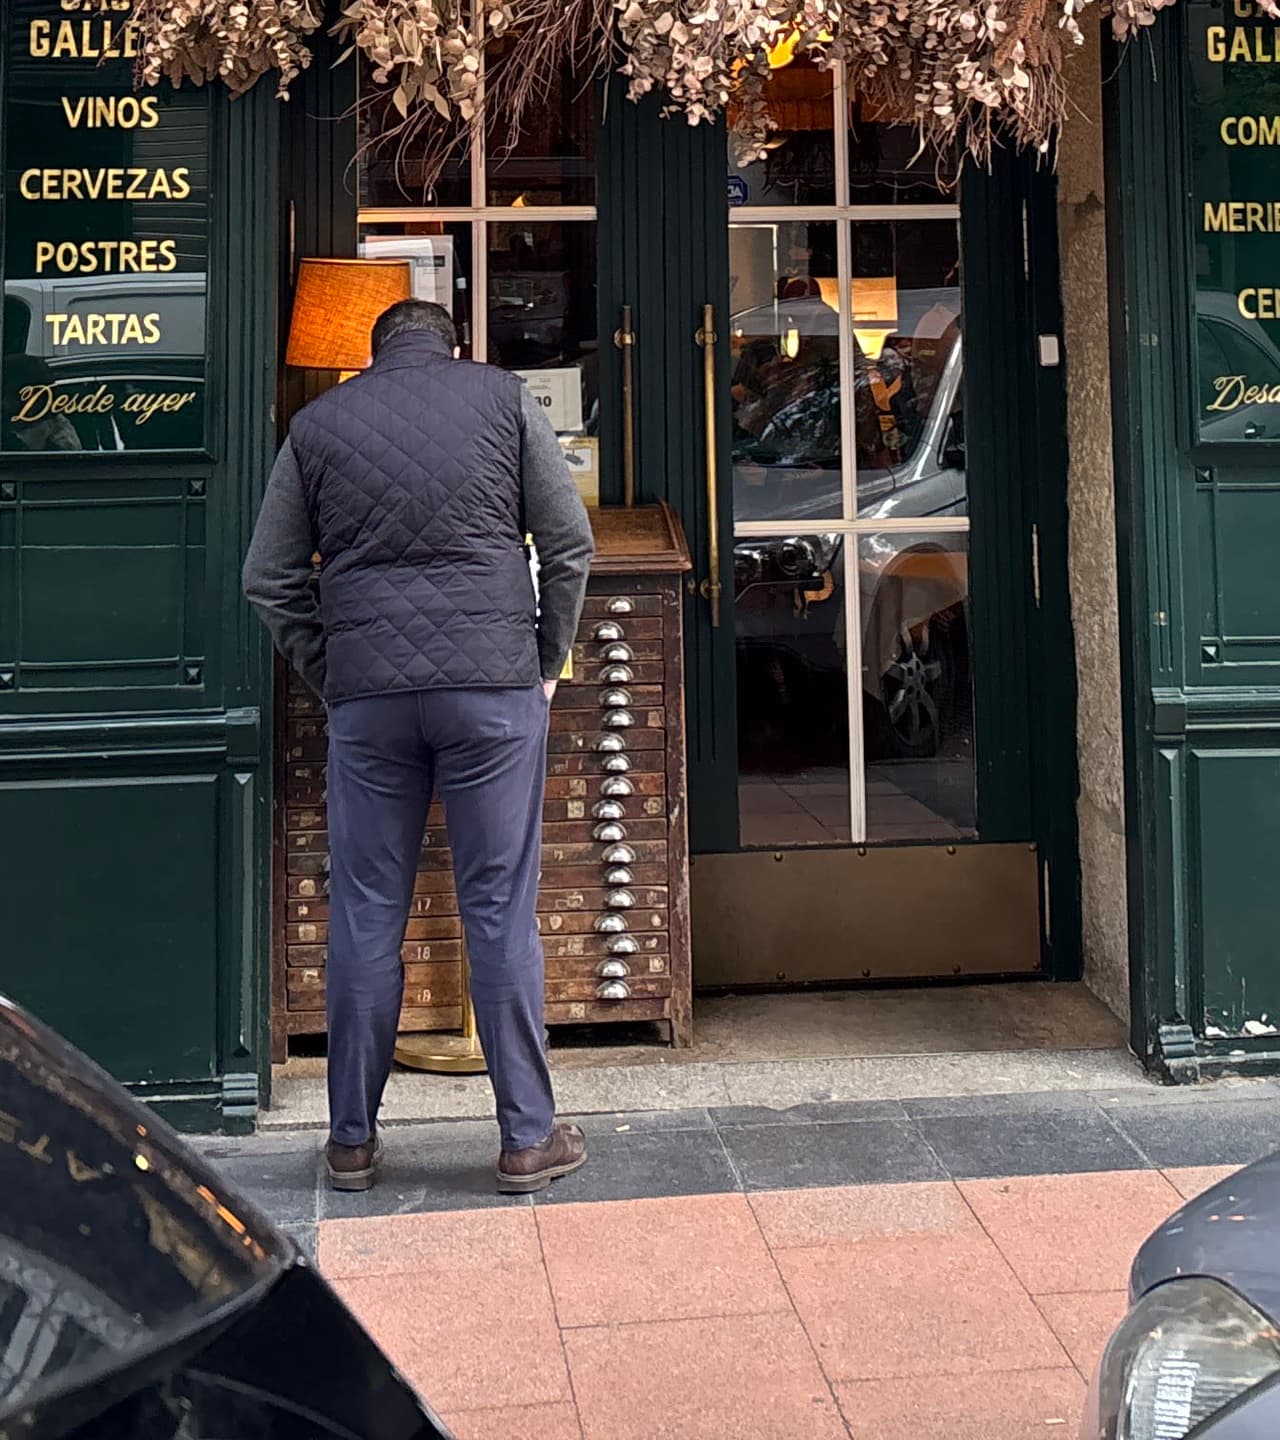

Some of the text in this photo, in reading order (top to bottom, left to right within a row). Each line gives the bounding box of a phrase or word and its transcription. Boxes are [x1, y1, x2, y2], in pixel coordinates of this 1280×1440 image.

[29, 20, 141, 57] GALLE
[61, 96, 160, 129] VINOS
[20, 167, 191, 200] CERVEZAS
[36, 240, 177, 273] POSTRES
[44, 313, 161, 345] TARTAS
[11, 384, 197, 426] Desde ayer
